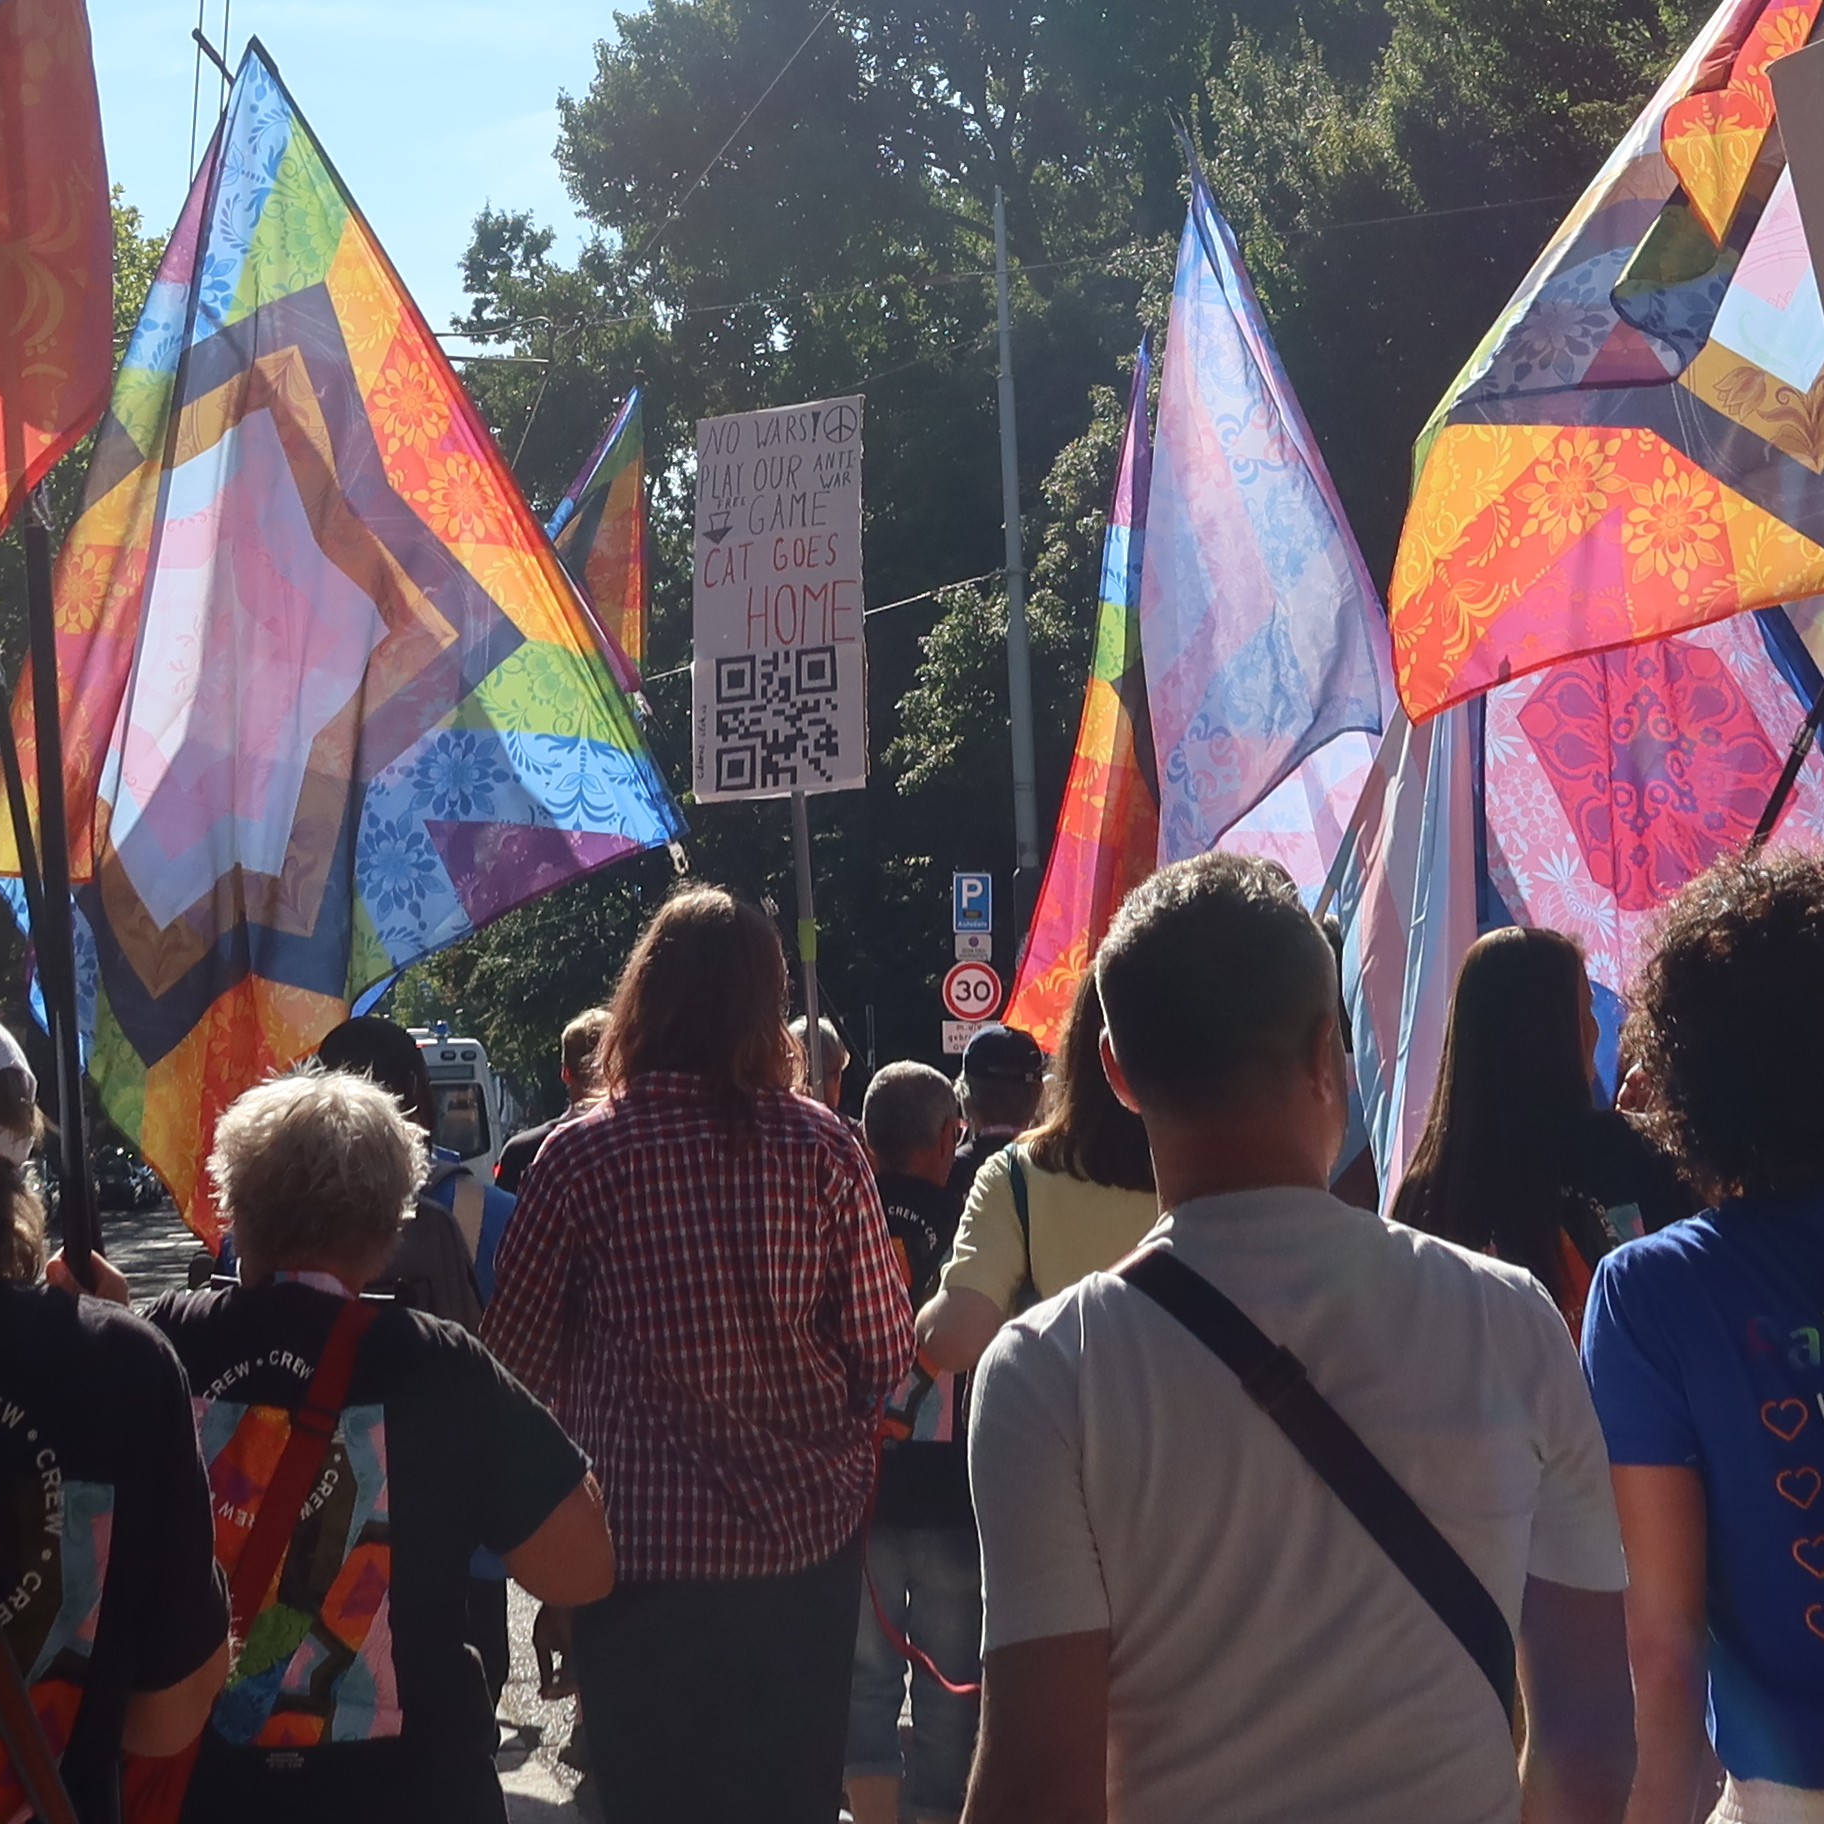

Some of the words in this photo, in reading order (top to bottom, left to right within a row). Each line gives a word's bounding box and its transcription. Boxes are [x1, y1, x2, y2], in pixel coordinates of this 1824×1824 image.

[702, 421, 741, 459] NO
[755, 411, 821, 450] WARS!
[700, 462, 744, 502] PLAY
[753, 454, 802, 491] OUR
[820, 471, 851, 489] WAR
[717, 497, 747, 510] FREE
[749, 491, 831, 535] GAME
[704, 541, 755, 588] CAT
[773, 533, 838, 571] GOES
[747, 579, 857, 649] HOME
[961, 878, 983, 908] P
[955, 981, 991, 1002] 30
[888, 1205, 919, 1222] CREW
[203, 1360, 249, 1403] CREW
[269, 1349, 315, 1380] CREW
[300, 1469, 339, 1521] CREW
[36, 1448, 65, 1537] CREW
